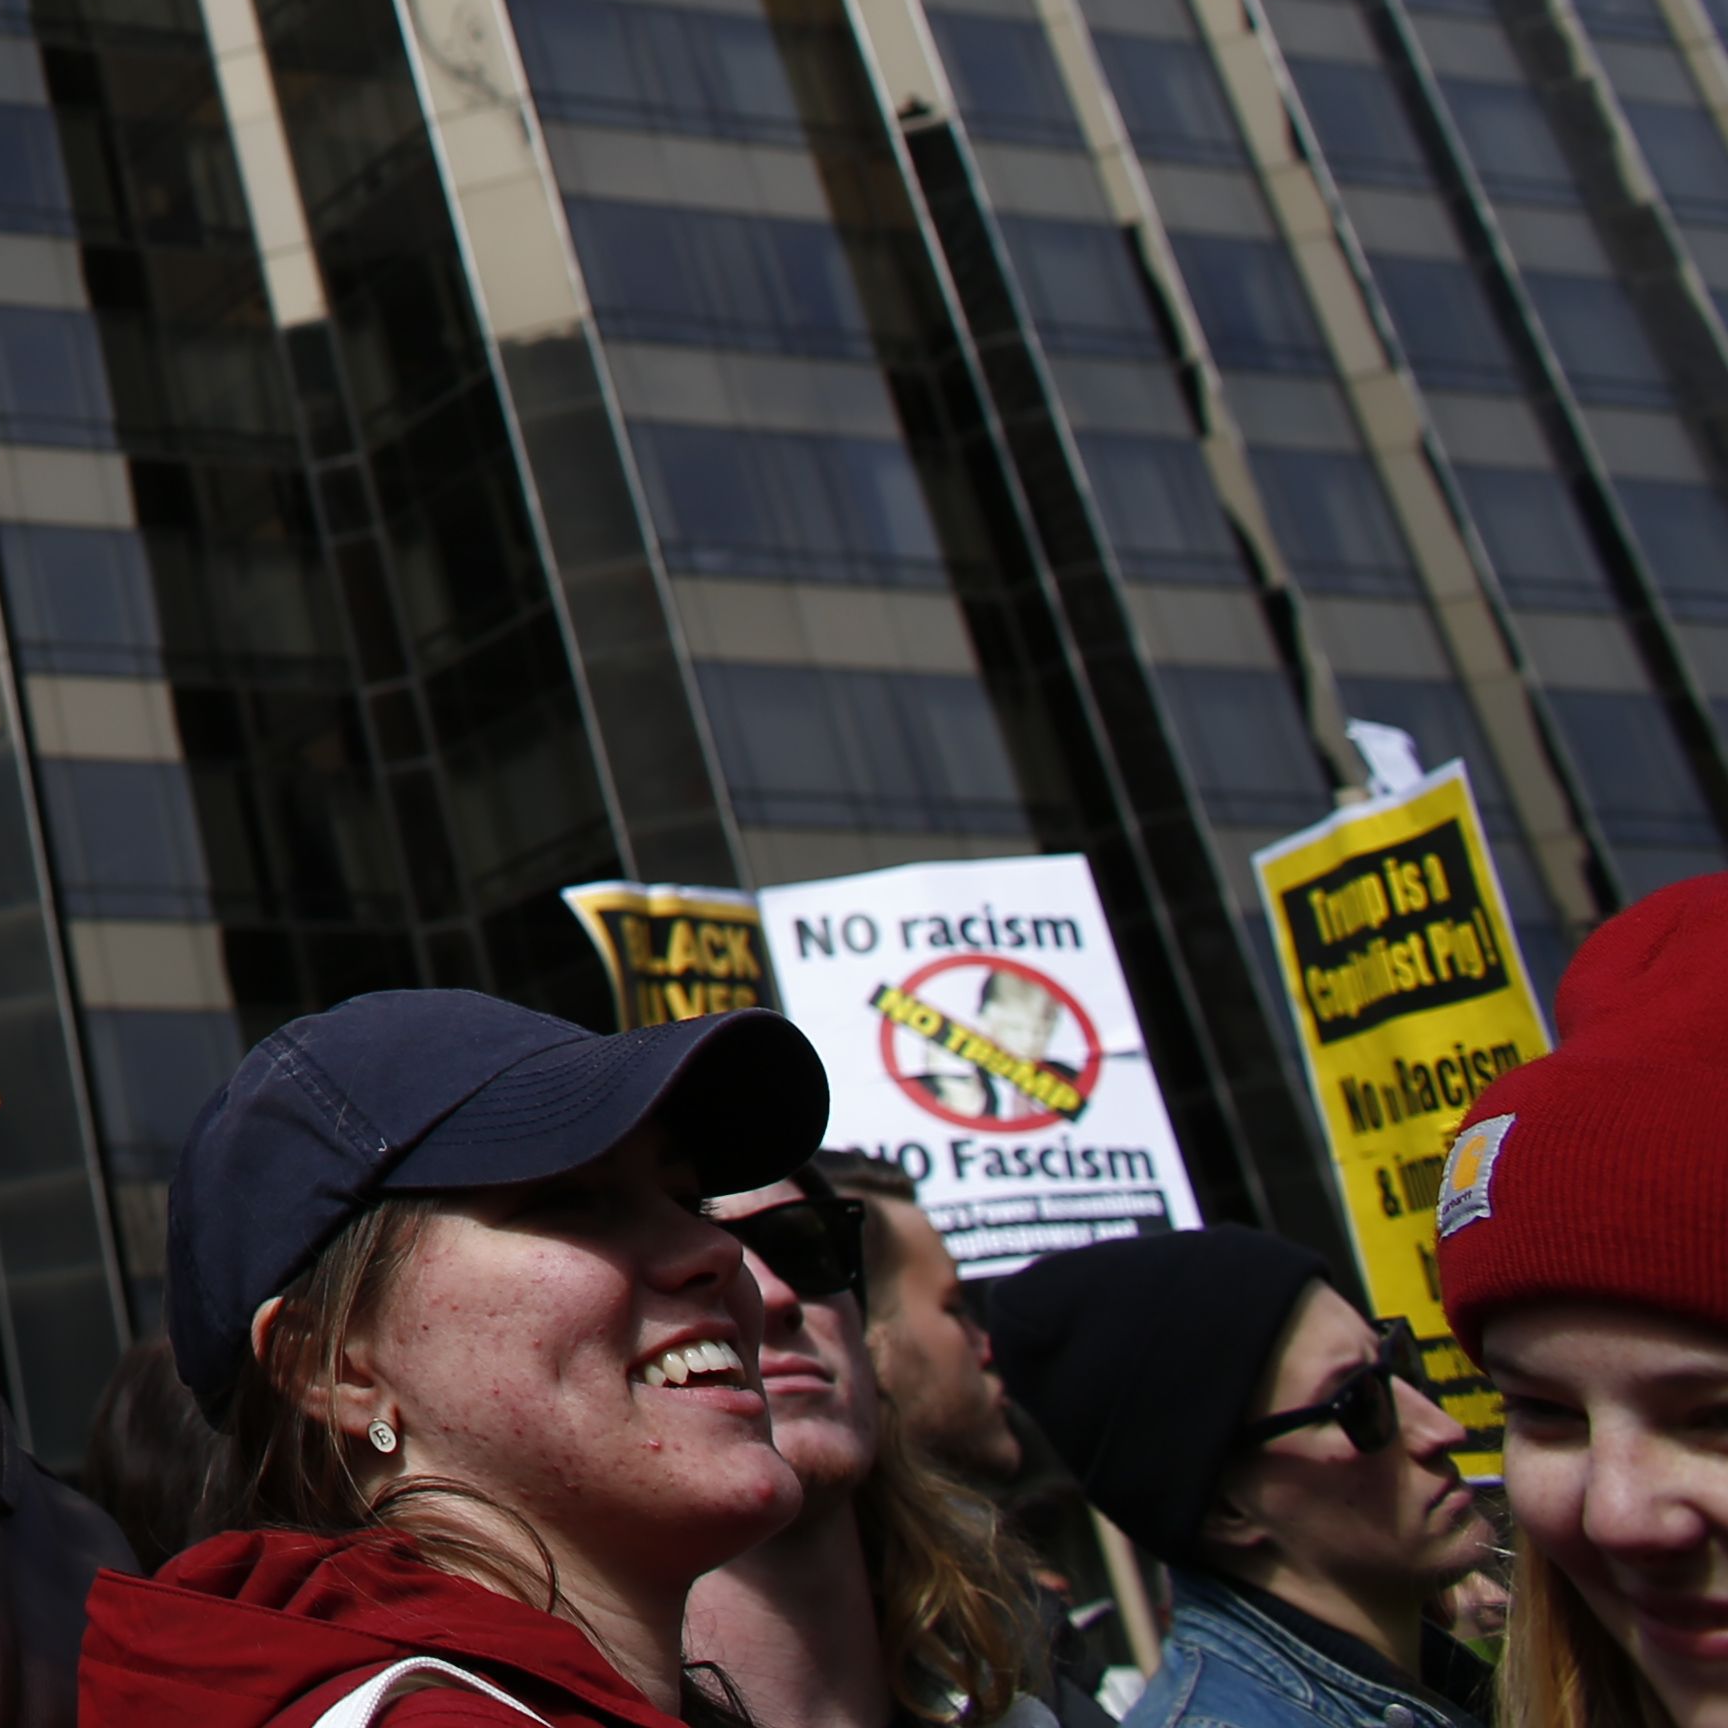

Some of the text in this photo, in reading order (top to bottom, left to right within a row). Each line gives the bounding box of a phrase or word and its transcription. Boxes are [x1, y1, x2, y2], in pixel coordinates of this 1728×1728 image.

[793, 902, 1083, 959] NO racism
[1308, 852, 1452, 946] Trump is a
[1305, 932, 1436, 1022] Capitalist
[876, 986, 1081, 1111] NO TRUMP
[950, 1135, 1155, 1180] Fascism
[373, 1427, 392, 1445] E
